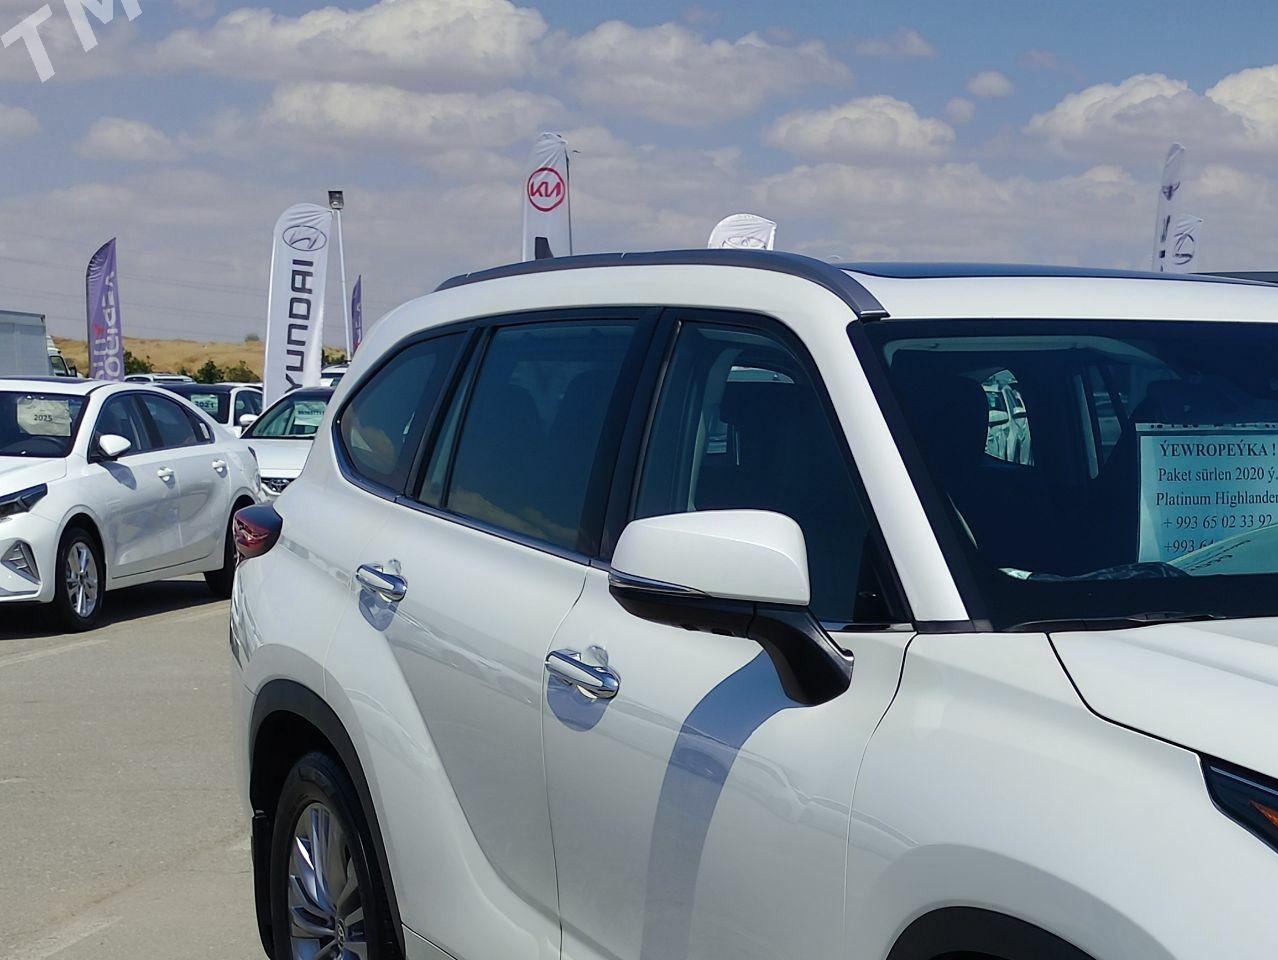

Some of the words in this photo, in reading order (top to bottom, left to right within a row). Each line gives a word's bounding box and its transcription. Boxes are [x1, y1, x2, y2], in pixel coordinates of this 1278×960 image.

[1159, 439, 1269, 457] ÝEWROPEÝKA
[1158, 467, 1192, 482] Paket
[1195, 467, 1232, 481] sürlen
[1235, 466, 1264, 481] 2020
[1267, 466, 1278, 483] ý.
[1156, 492, 1211, 506] Platinum
[1176, 516, 1198, 529] 993
[1203, 515, 1217, 529] 65
[1221, 515, 1236, 529] 02
[1240, 515, 1254, 528] 33
[1164, 540, 1195, 553] +993
